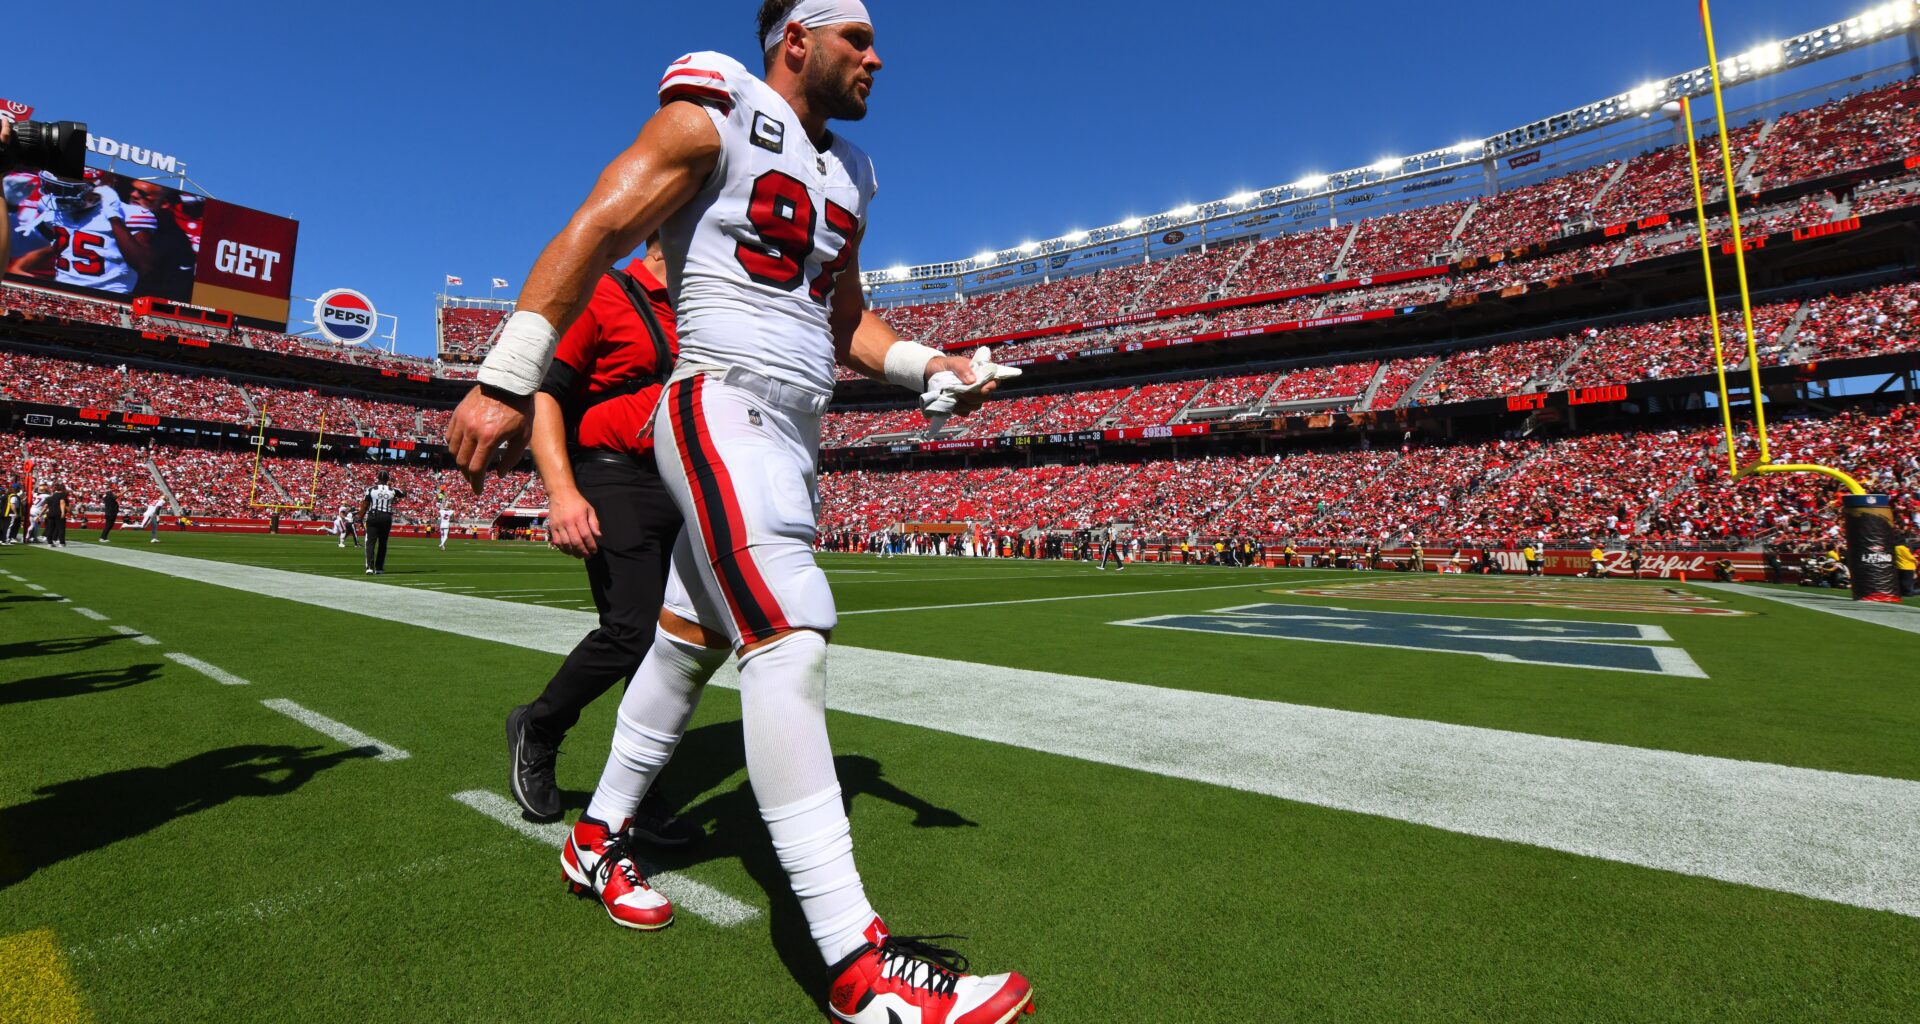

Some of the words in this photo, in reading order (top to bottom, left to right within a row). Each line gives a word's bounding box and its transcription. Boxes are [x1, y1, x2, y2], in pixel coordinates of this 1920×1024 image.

[754, 115, 783, 144] C
[735, 169, 860, 304] 97
[214, 239, 281, 282] GET
[324, 307, 370, 325] PEPSI
[1507, 393, 1548, 411] GET
[1568, 384, 1628, 406] LOUD
[68, 419, 100, 428] LEXUS
[80, 408, 110, 421] GET
[123, 412, 160, 426] LOUD
[1015, 436, 1031, 446] 12:14
[1050, 432, 1062, 444] 2ND
[1092, 431, 1101, 441] 38
[1142, 426, 1172, 438] 49ERS
[279, 439, 298, 447] TOYOTA
[937, 440, 975, 449] CARDINALS
[1543, 556, 1560, 568] OF
[1566, 556, 1592, 569] THE
